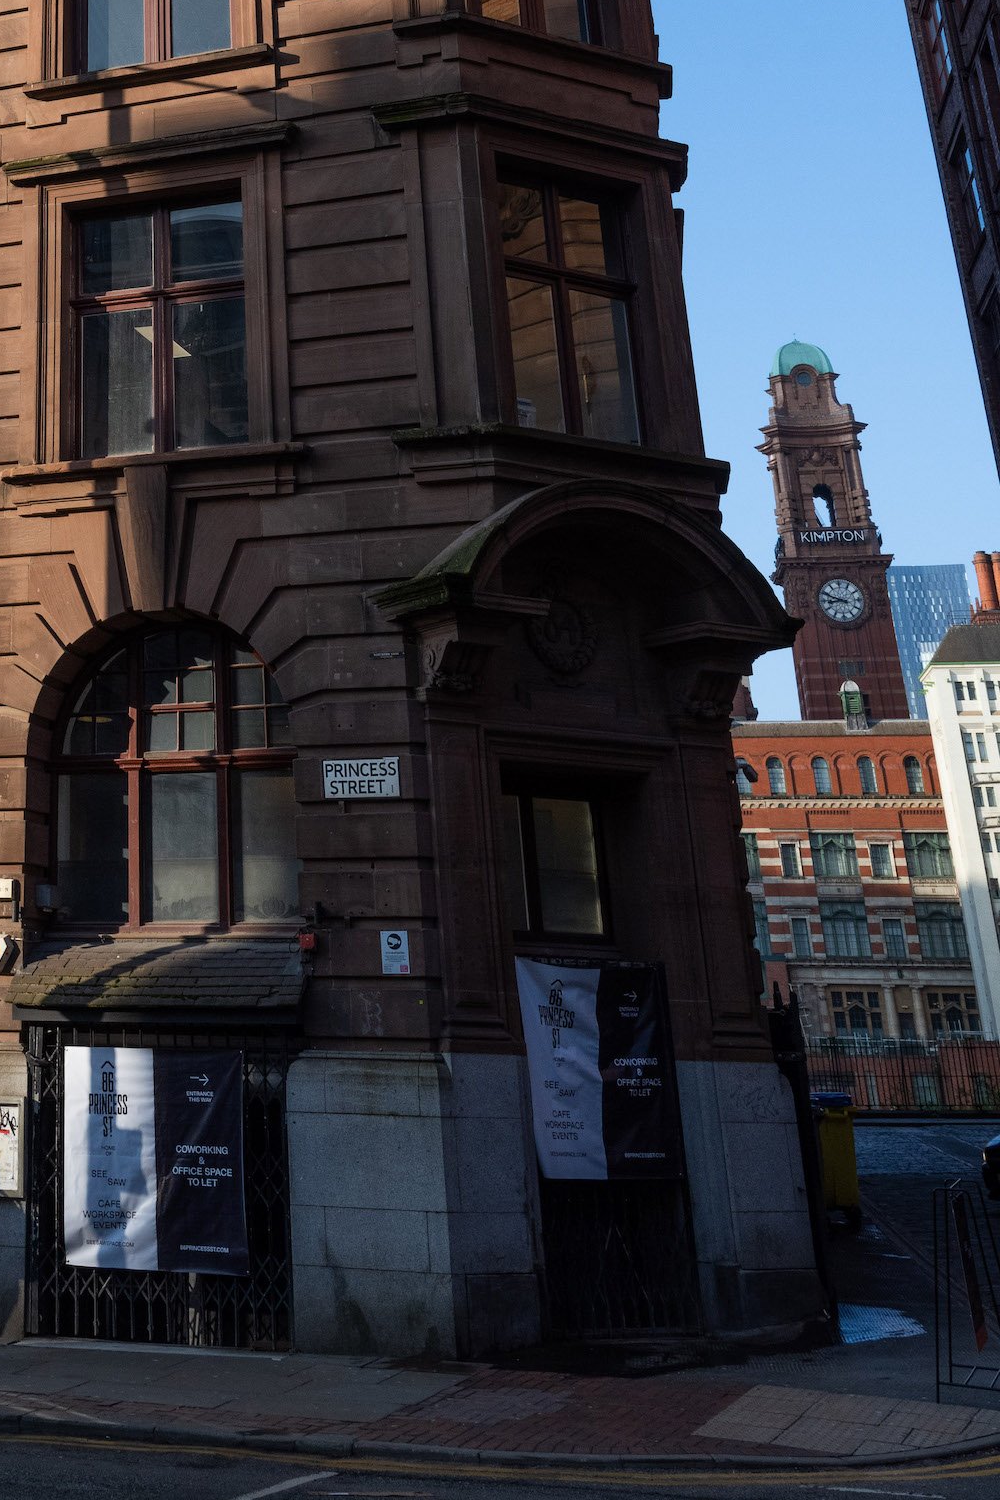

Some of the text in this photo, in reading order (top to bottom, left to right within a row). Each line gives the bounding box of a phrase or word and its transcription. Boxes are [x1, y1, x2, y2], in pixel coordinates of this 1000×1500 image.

[800, 530, 865, 543] KIMPTON
[325, 762, 396, 778] PRINCESS
[330, 779, 386, 795] STREET
[549, 989, 563, 1007] 86
[538, 1005, 575, 1028] PRINCESS
[613, 1057, 658, 1067] COWORKING
[102, 1072, 114, 1092] 86
[544, 1080, 559, 1089] SEE
[617, 1078, 662, 1087] OFFICE SPACE
[559, 1089, 576, 1098] SAW
[629, 1088, 652, 1097] TO LET
[89, 1094, 128, 1115] PRINCESS
[552, 1110, 571, 1119] CAFE
[544, 1120, 585, 1130] WORKSPACE
[552, 1132, 579, 1141] EVENTS
[175, 1145, 229, 1155] COWORKING
[198, 1156, 206, 1165] &
[91, 1170, 108, 1178] SEE
[172, 1166, 233, 1177] OFFICE SPACE
[107, 1178, 127, 1186] SAW
[187, 1177, 218, 1188] TO LET
[98, 1199, 121, 1208] CAFE
[83, 1210, 137, 1219] WORKSPACE
[93, 1221, 127, 1230] EVENTS
